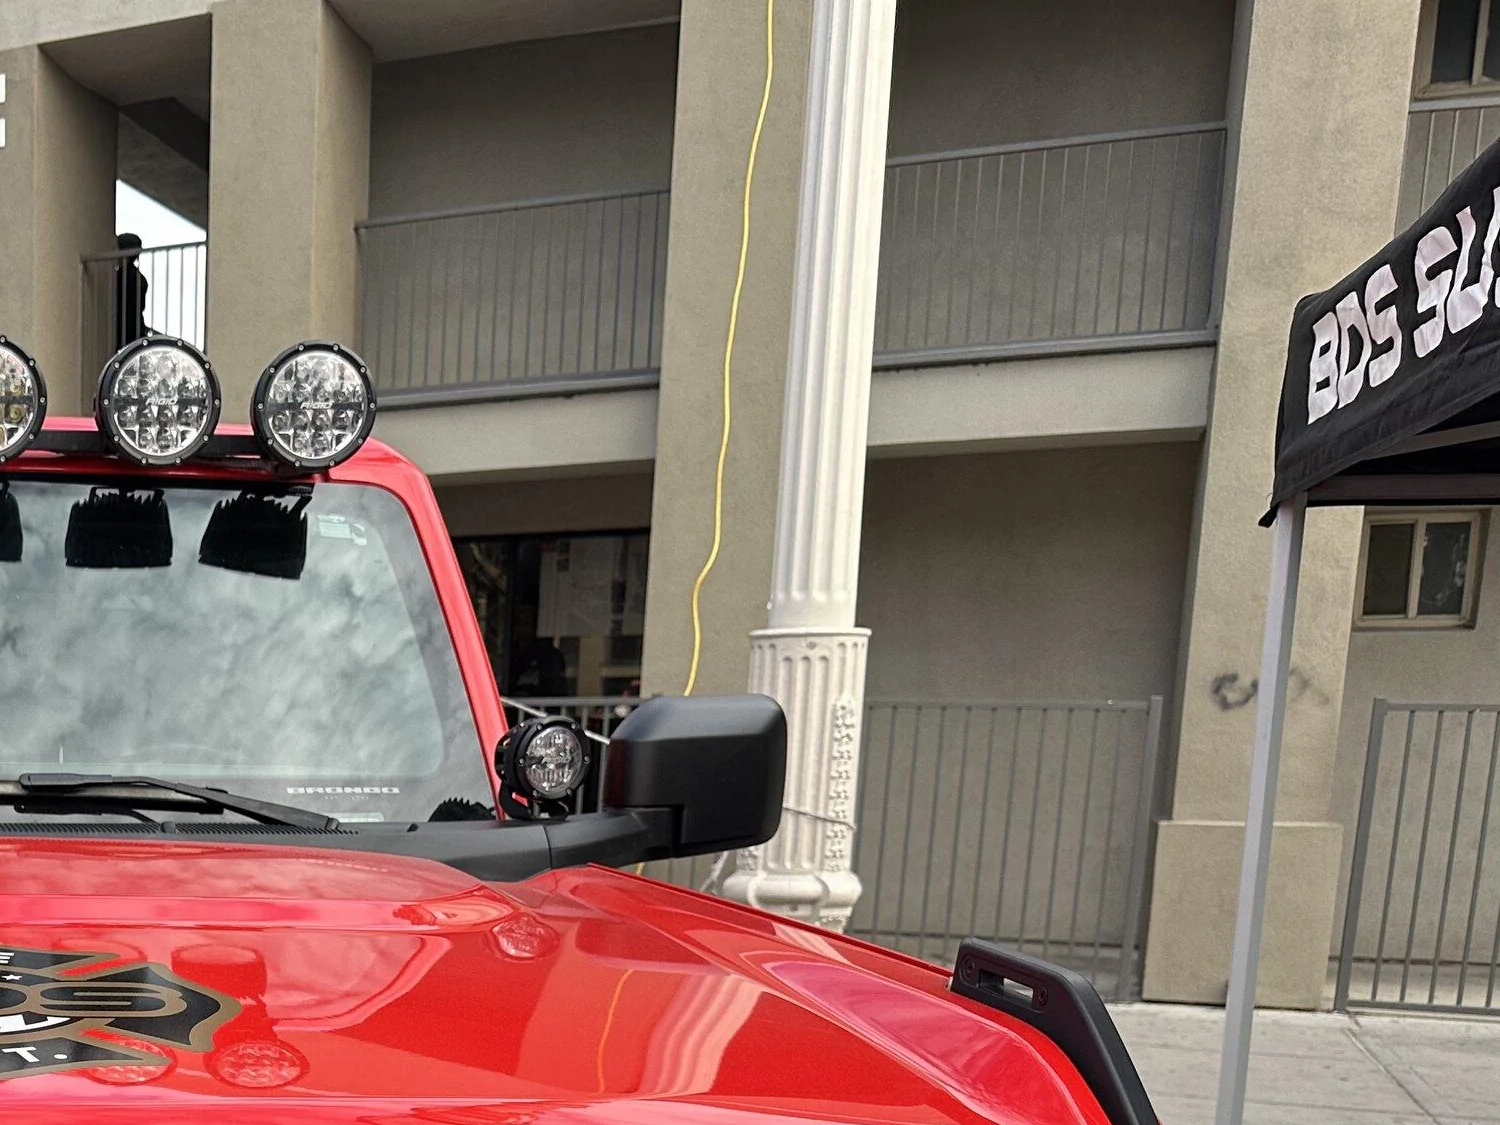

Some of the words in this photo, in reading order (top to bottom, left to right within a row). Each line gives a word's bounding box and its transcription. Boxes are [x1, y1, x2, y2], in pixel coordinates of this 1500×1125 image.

[1307, 264, 1402, 425] BDS
[1413, 186, 1500, 358] SU
[144, 397, 178, 406] RIGID
[300, 401, 334, 410] RIGID
